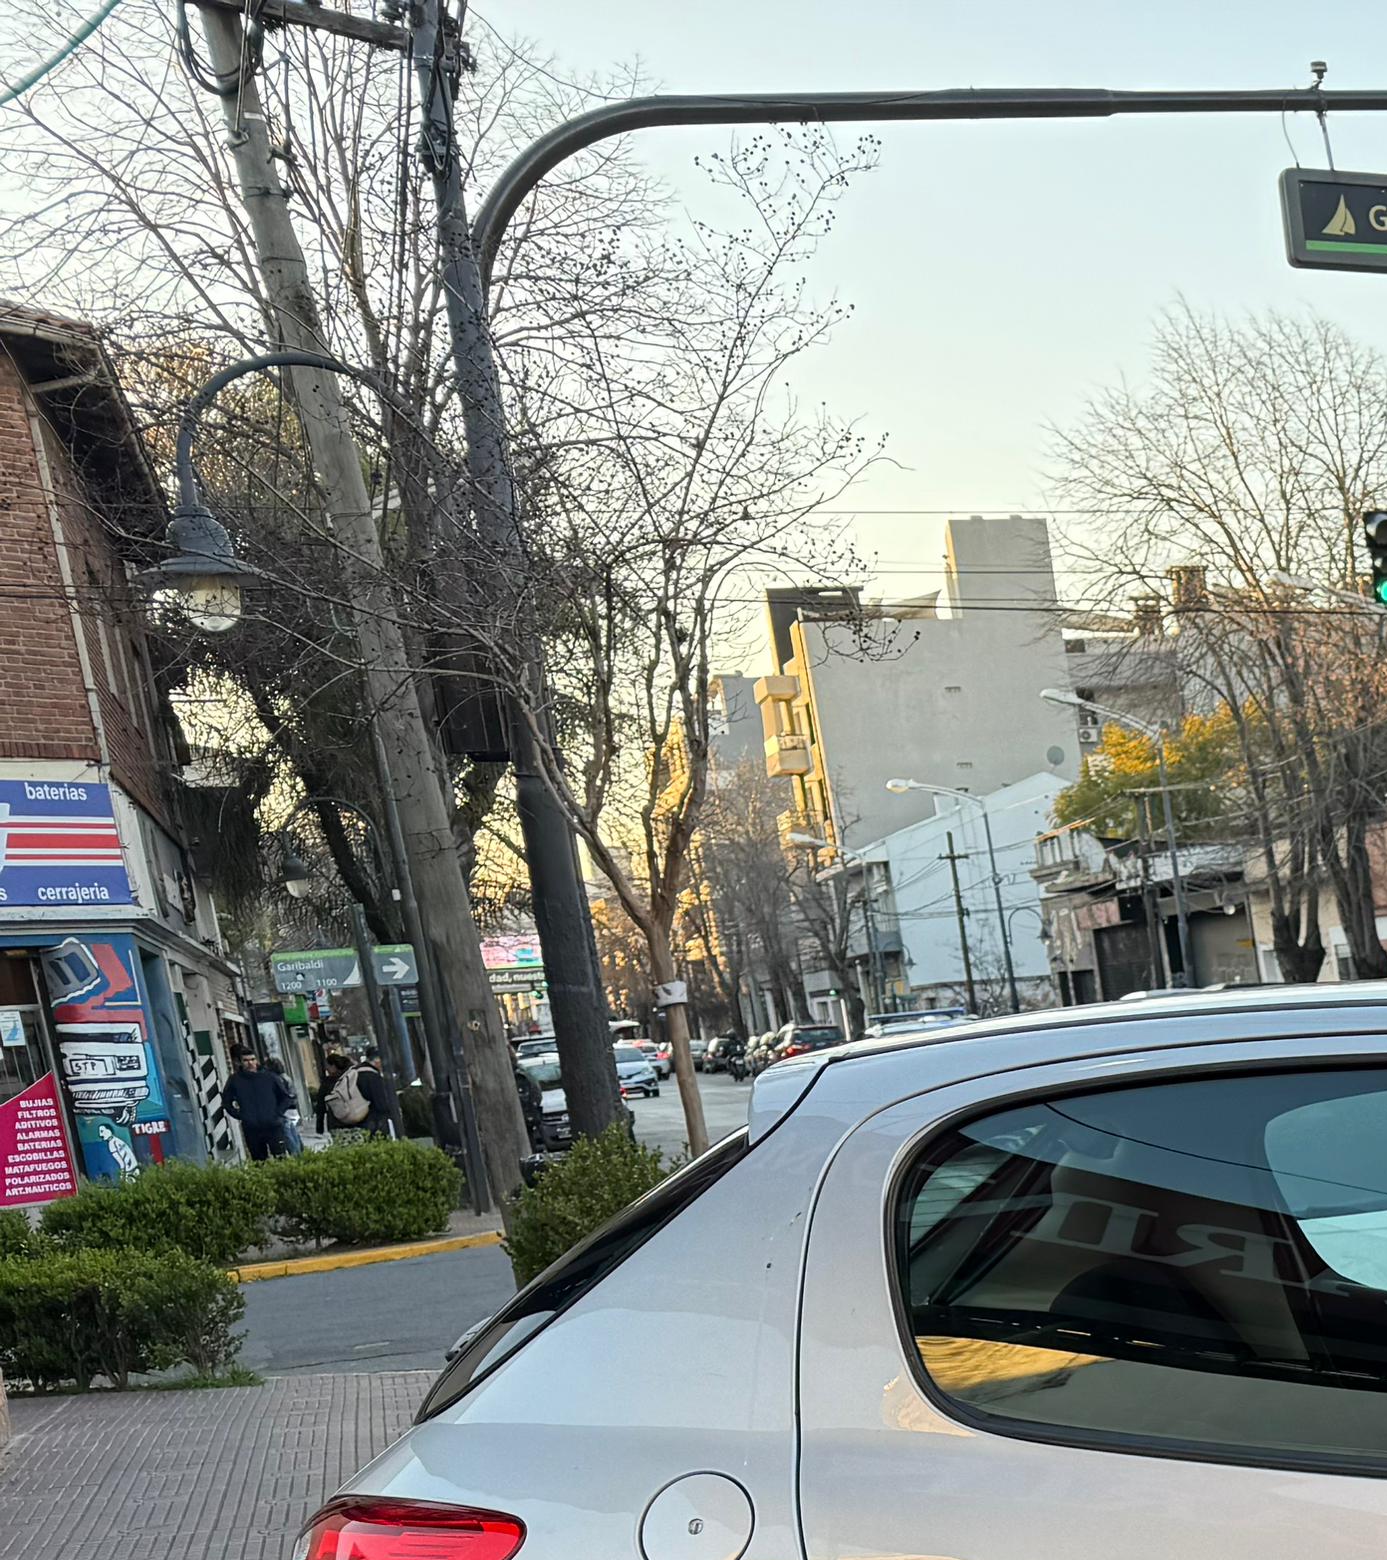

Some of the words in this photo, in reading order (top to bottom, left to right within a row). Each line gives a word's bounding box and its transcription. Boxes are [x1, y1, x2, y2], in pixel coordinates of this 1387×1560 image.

[24, 782, 88, 800] baterias
[38, 882, 109, 903] cerrajeria
[277, 959, 324, 971] Garibaldi
[281, 981, 302, 990] 1200
[317, 978, 337, 986] 1100
[75, 1060, 98, 1072] STP
[20, 1098, 53, 1109] BUJIAS
[17, 1108, 56, 1119] FILTROS
[15, 1118, 58, 1130] ADITIVOS
[132, 1121, 167, 1135] TIGRE
[16, 1129, 60, 1141] ALARMAS
[17, 1139, 62, 1151] BATERIAS
[8, 1150, 65, 1163] ESCOBILLAS
[5, 1161, 68, 1175] MATAFUEGOS
[5, 1172, 70, 1186] POLARIZADOS
[5, 1182, 72, 1197] ART.NAUTICOS
